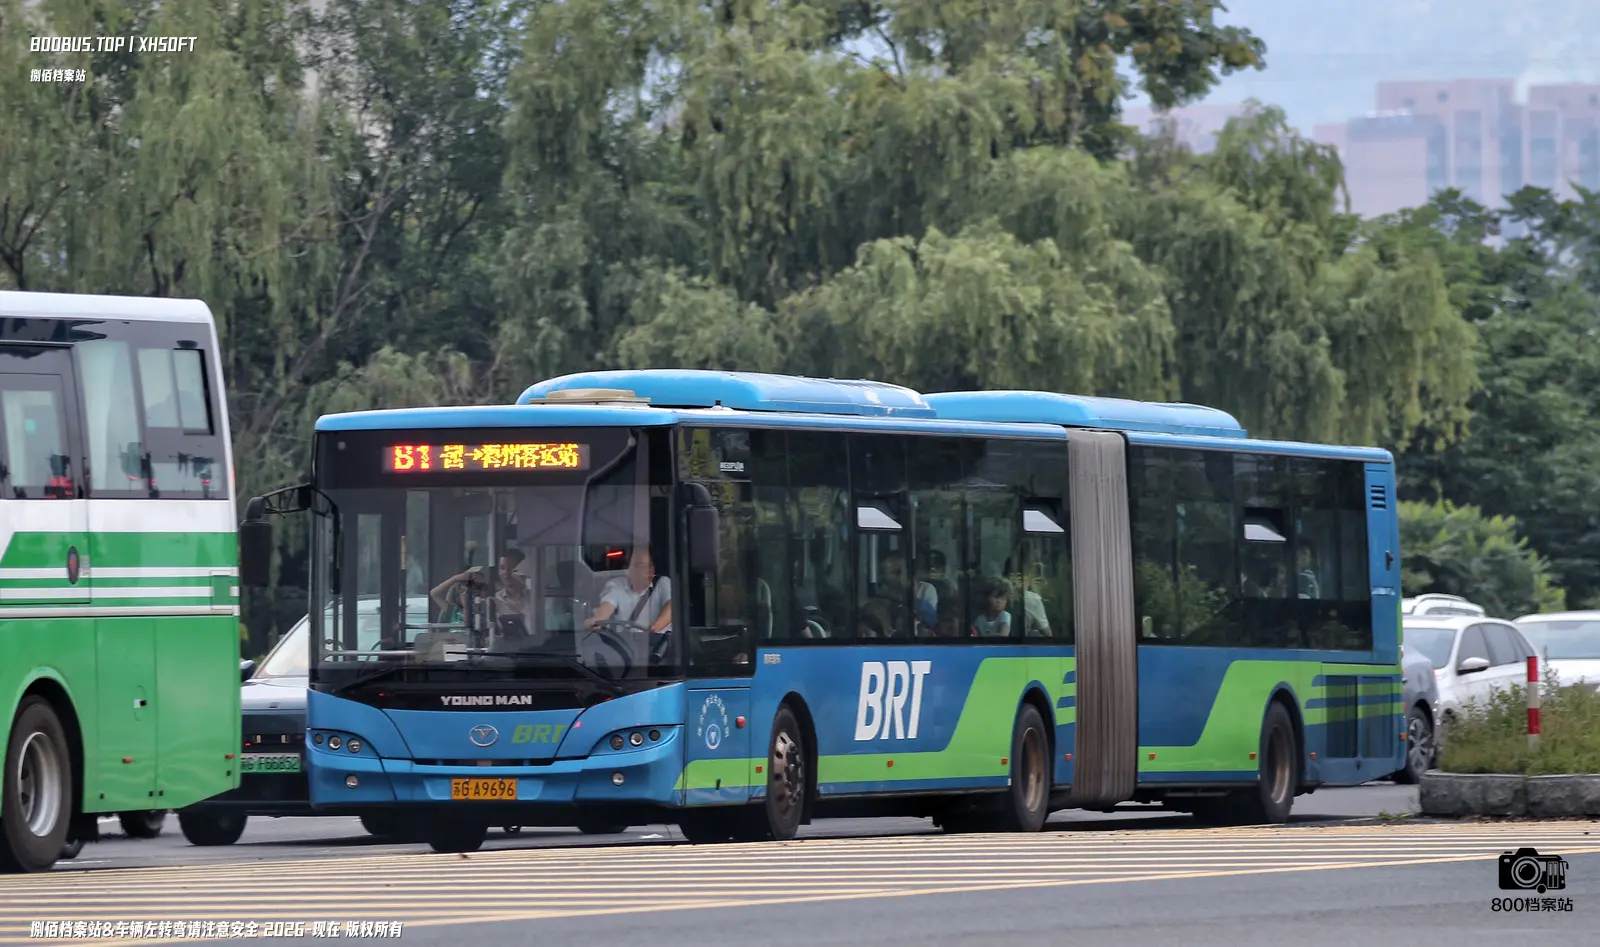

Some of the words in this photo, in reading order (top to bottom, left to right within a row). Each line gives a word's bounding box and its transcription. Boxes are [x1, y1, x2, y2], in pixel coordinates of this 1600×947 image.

[394, 445, 430, 469] B1
[440, 695, 494, 706] YOUNG
[496, 695, 532, 705] MAN
[854, 660, 932, 741] BRT
[511, 724, 568, 744] BRT
